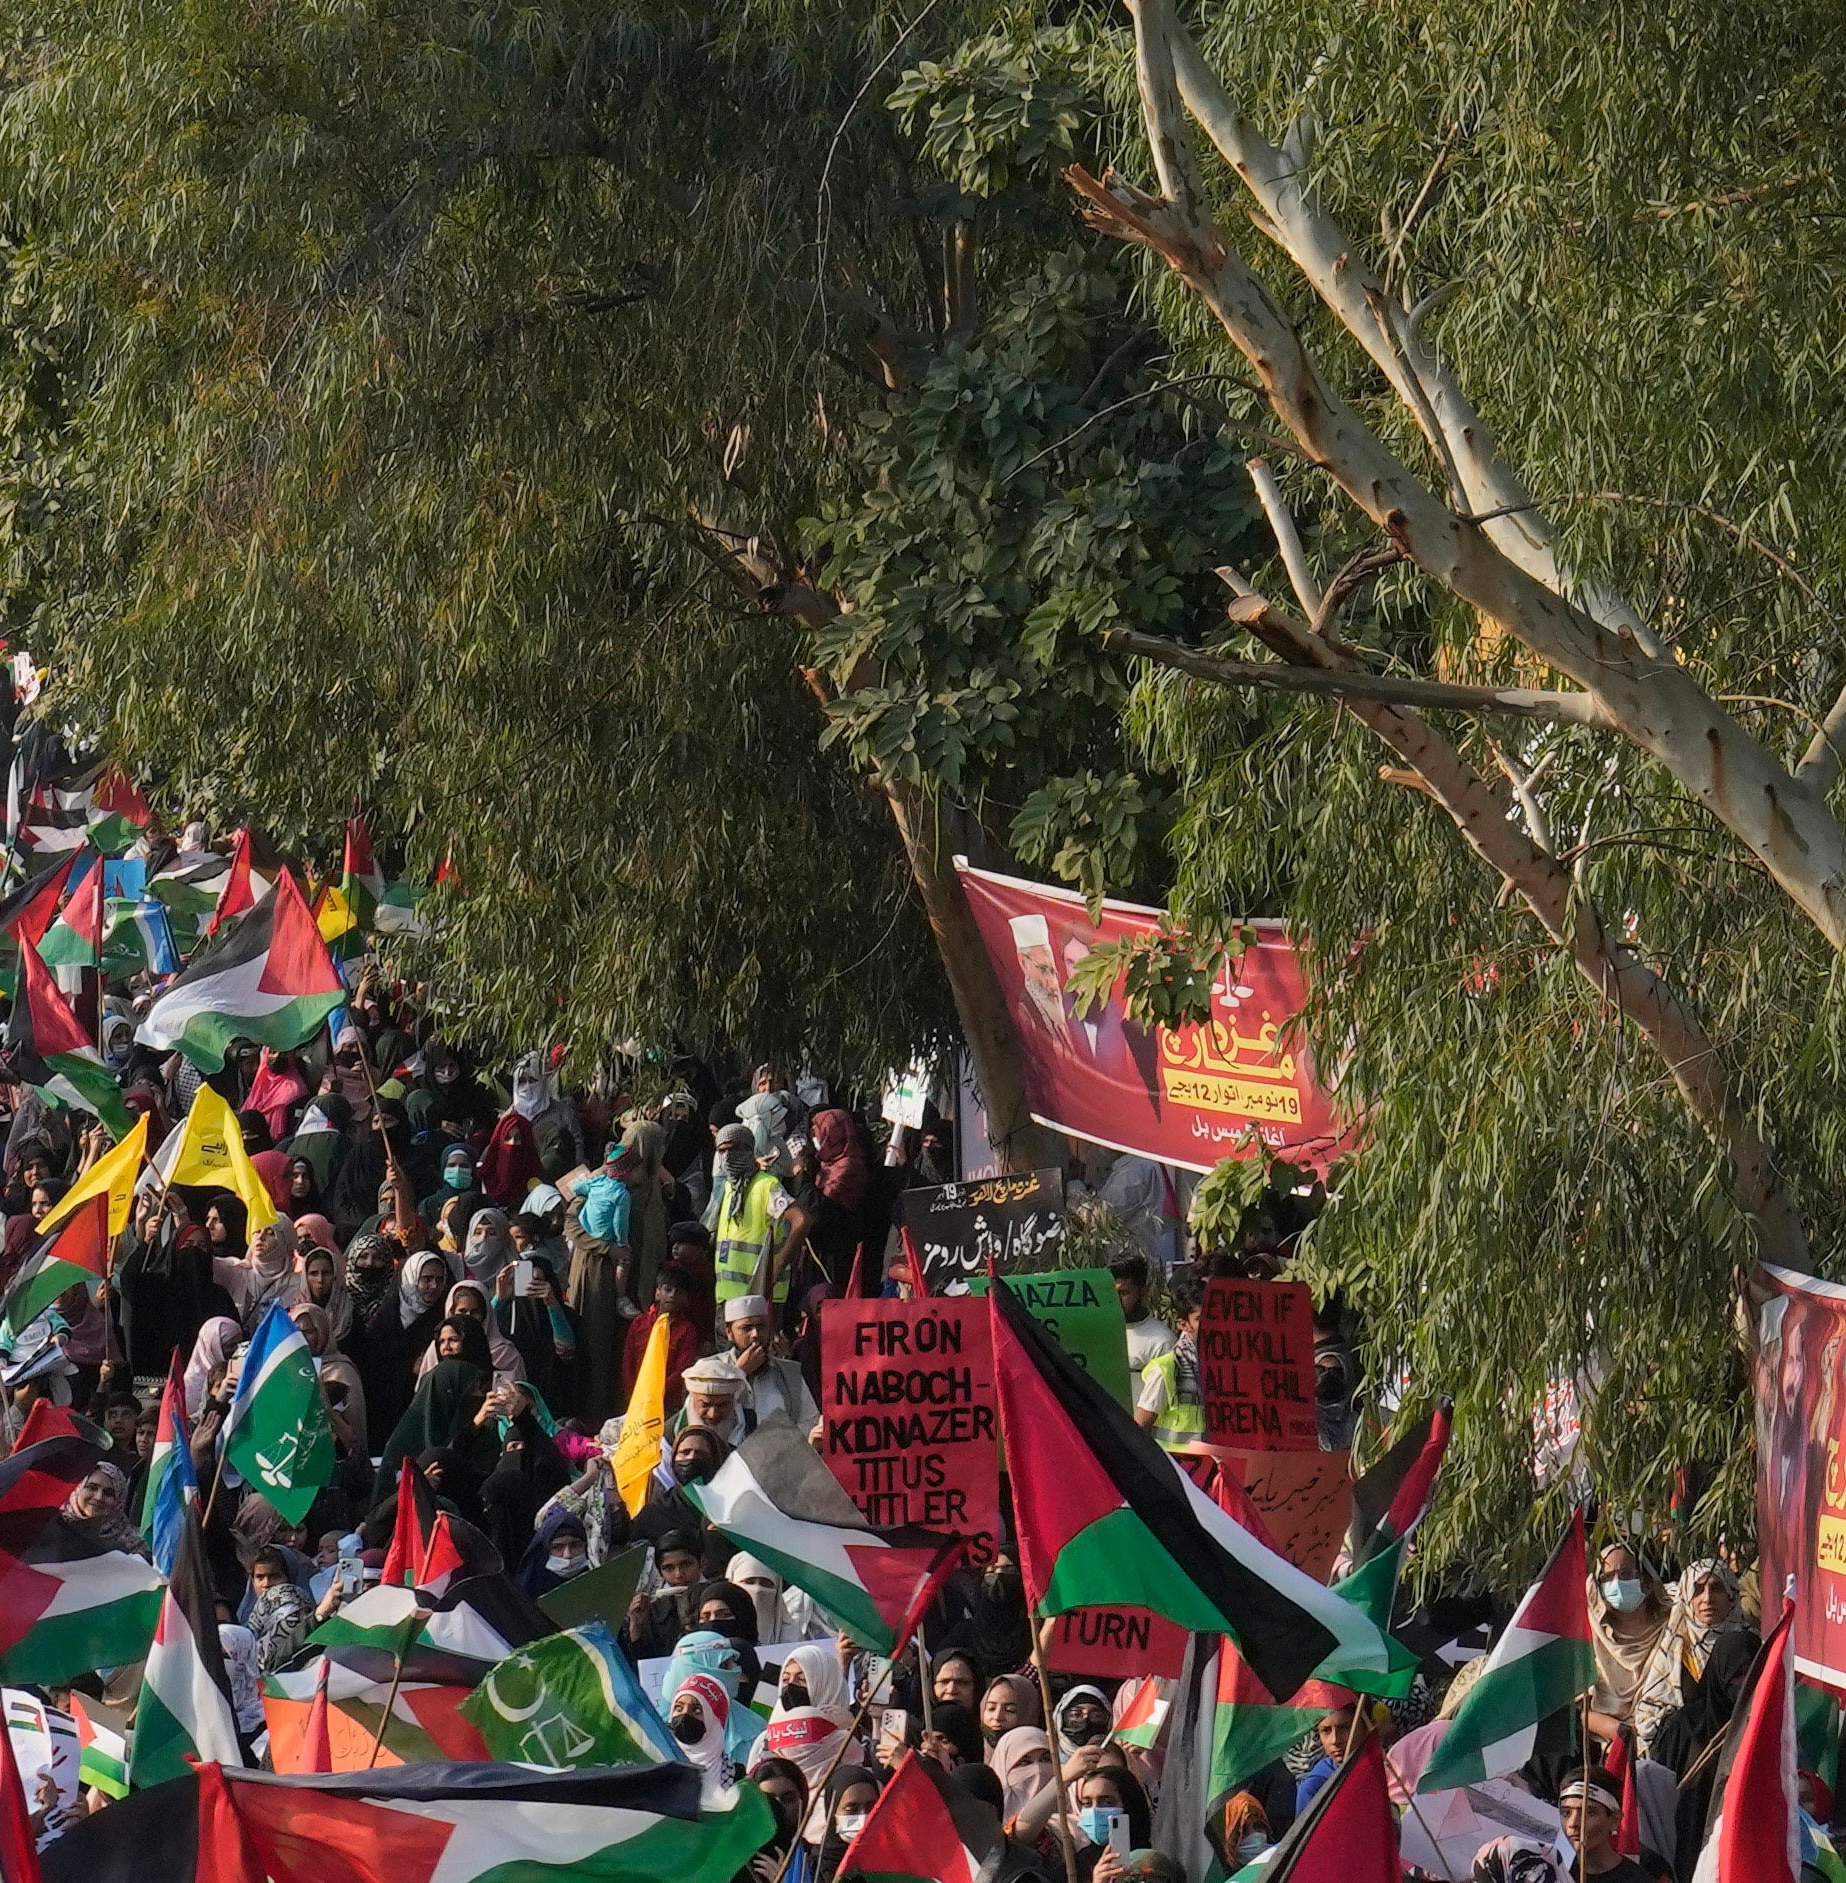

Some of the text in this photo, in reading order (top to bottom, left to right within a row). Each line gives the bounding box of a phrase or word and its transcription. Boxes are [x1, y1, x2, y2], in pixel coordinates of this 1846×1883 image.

[1161, 1022, 1297, 1081] مارچ
[1212, 1010, 1284, 1062] غزہ
[1191, 1082, 1210, 1101] 12
[1278, 1096, 1299, 1116] 19
[943, 1183, 958, 1202] 19
[1208, 1289, 1295, 1324] EVEN IF
[1205, 1329, 1296, 1365] YOU KILL
[1204, 1364, 1249, 1398] ALL
[852, 1453, 946, 1492] TITUS
[1062, 1610, 1151, 1651] TURN
